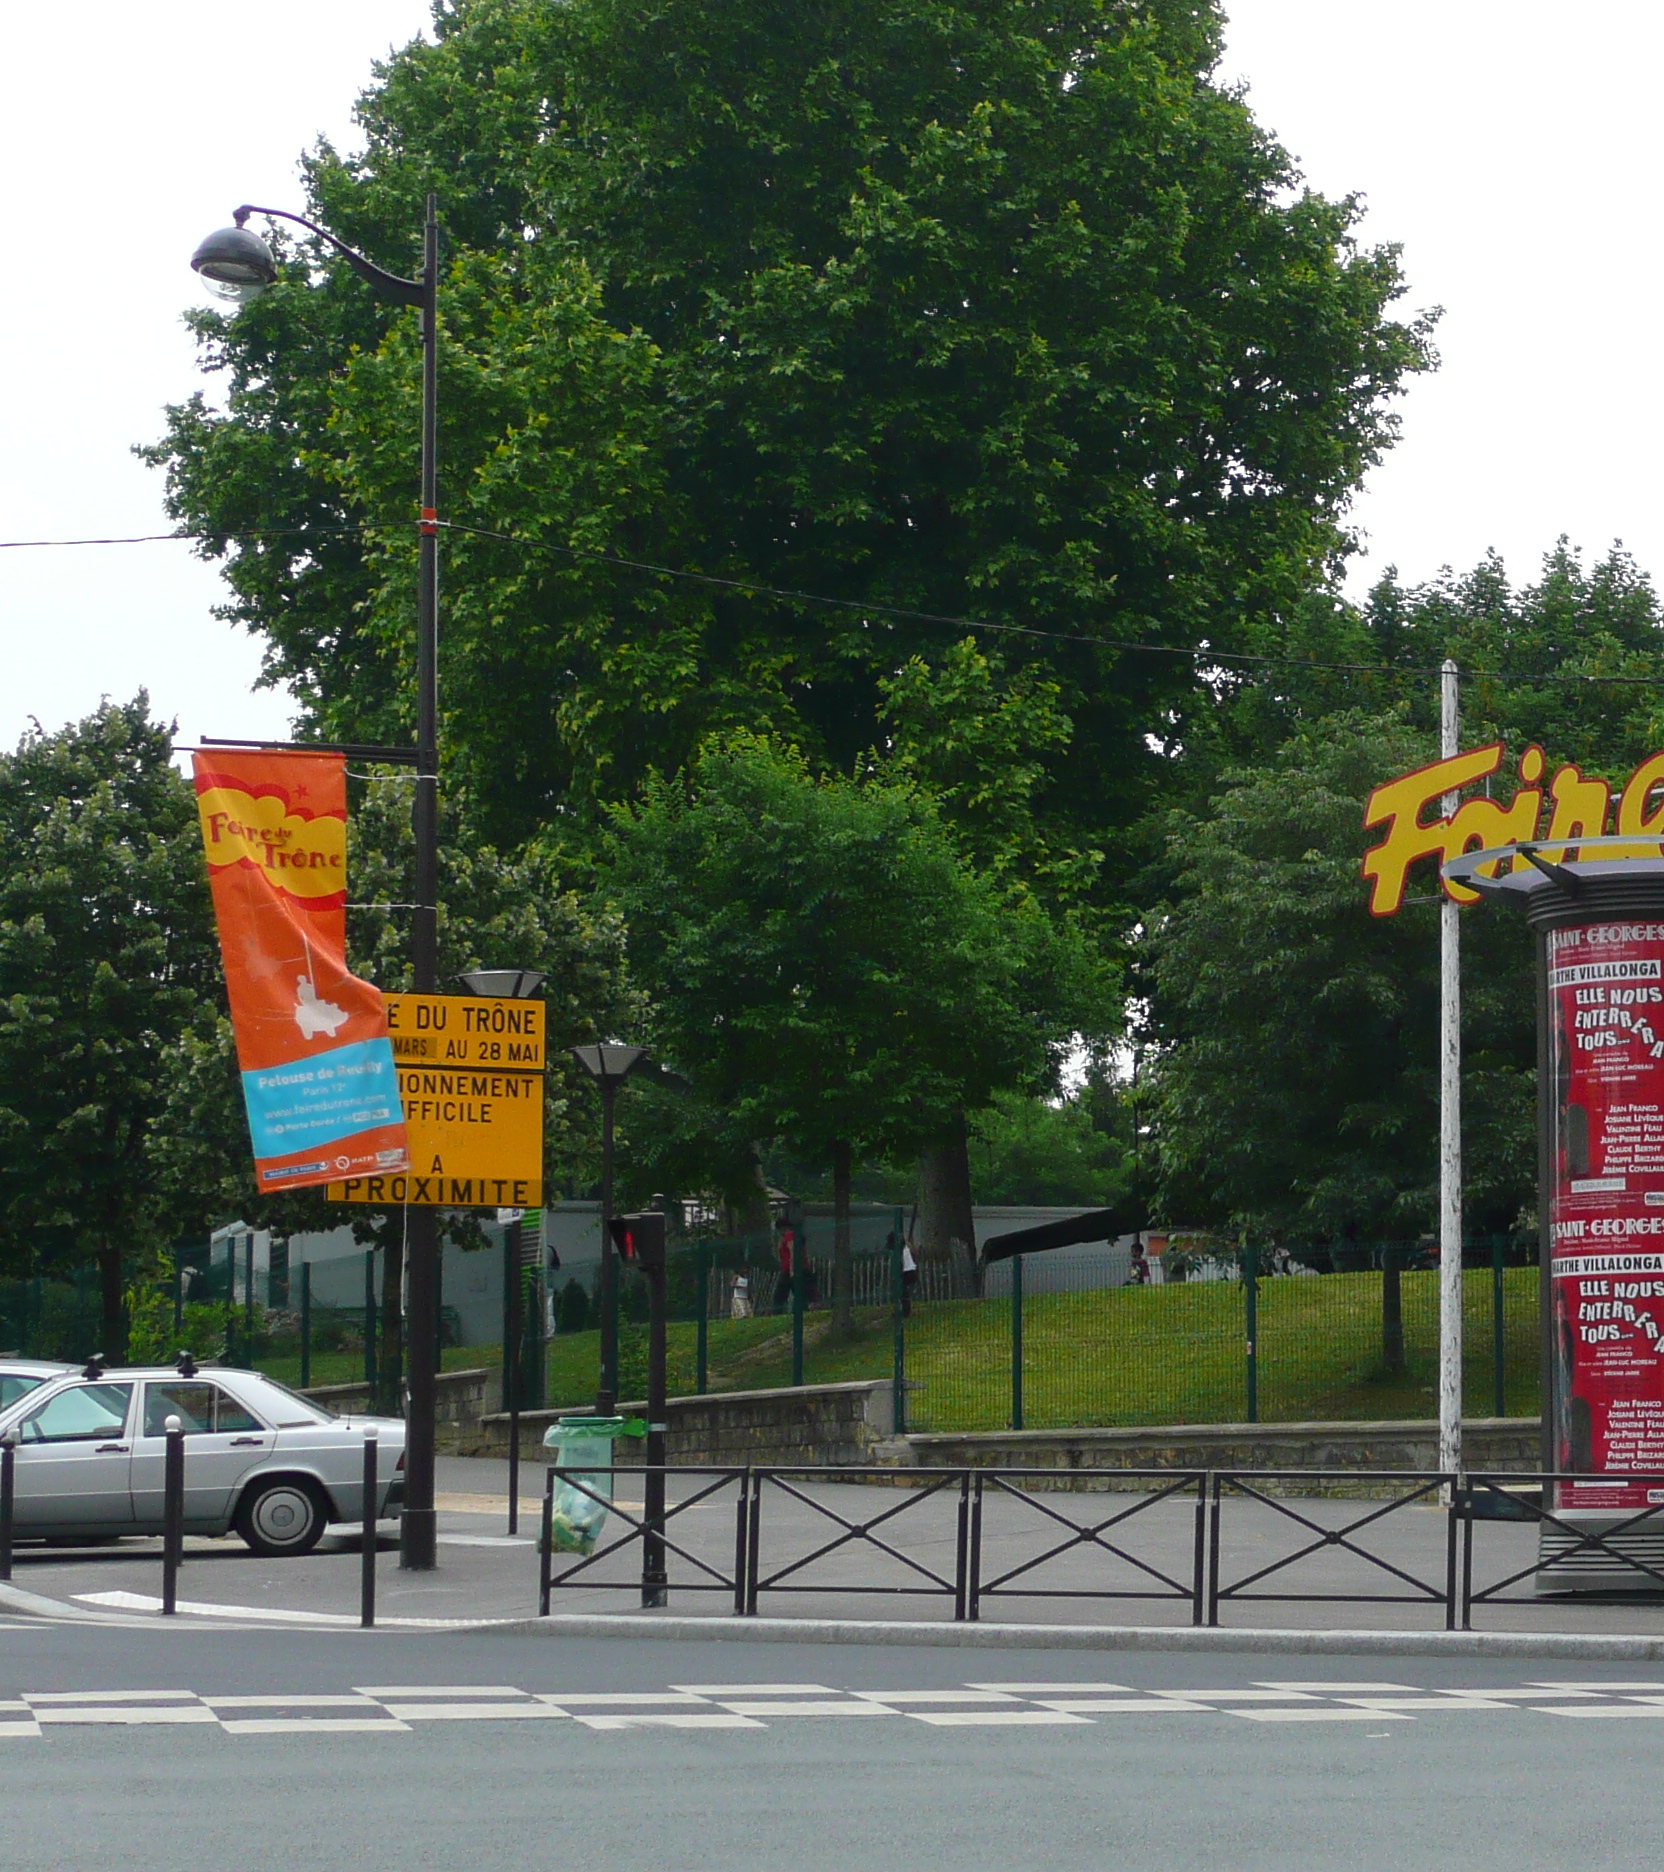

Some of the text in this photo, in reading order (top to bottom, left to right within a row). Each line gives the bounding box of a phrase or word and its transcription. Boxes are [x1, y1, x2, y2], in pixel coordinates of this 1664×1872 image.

[255, 838, 342, 869] Trône
[1579, 962, 1659, 980] VILLALONGA
[1575, 986, 1663, 1005] ELLE NOUS
[416, 1005, 447, 1030] DU
[462, 1002, 537, 1035] TRÔNE
[445, 1040, 468, 1060] AU
[478, 1042, 501, 1061] 28
[507, 1043, 539, 1063] MAI
[258, 1072, 314, 1088] Pelouse
[317, 1068, 334, 1080] de
[398, 1073, 534, 1098] IONNEMENT
[430, 1154, 443, 1174] A
[343, 1176, 529, 1205] PROXIMITE
[1583, 1256, 1663, 1271] VILLALONGA
[1579, 1280, 1610, 1297] ELLE
